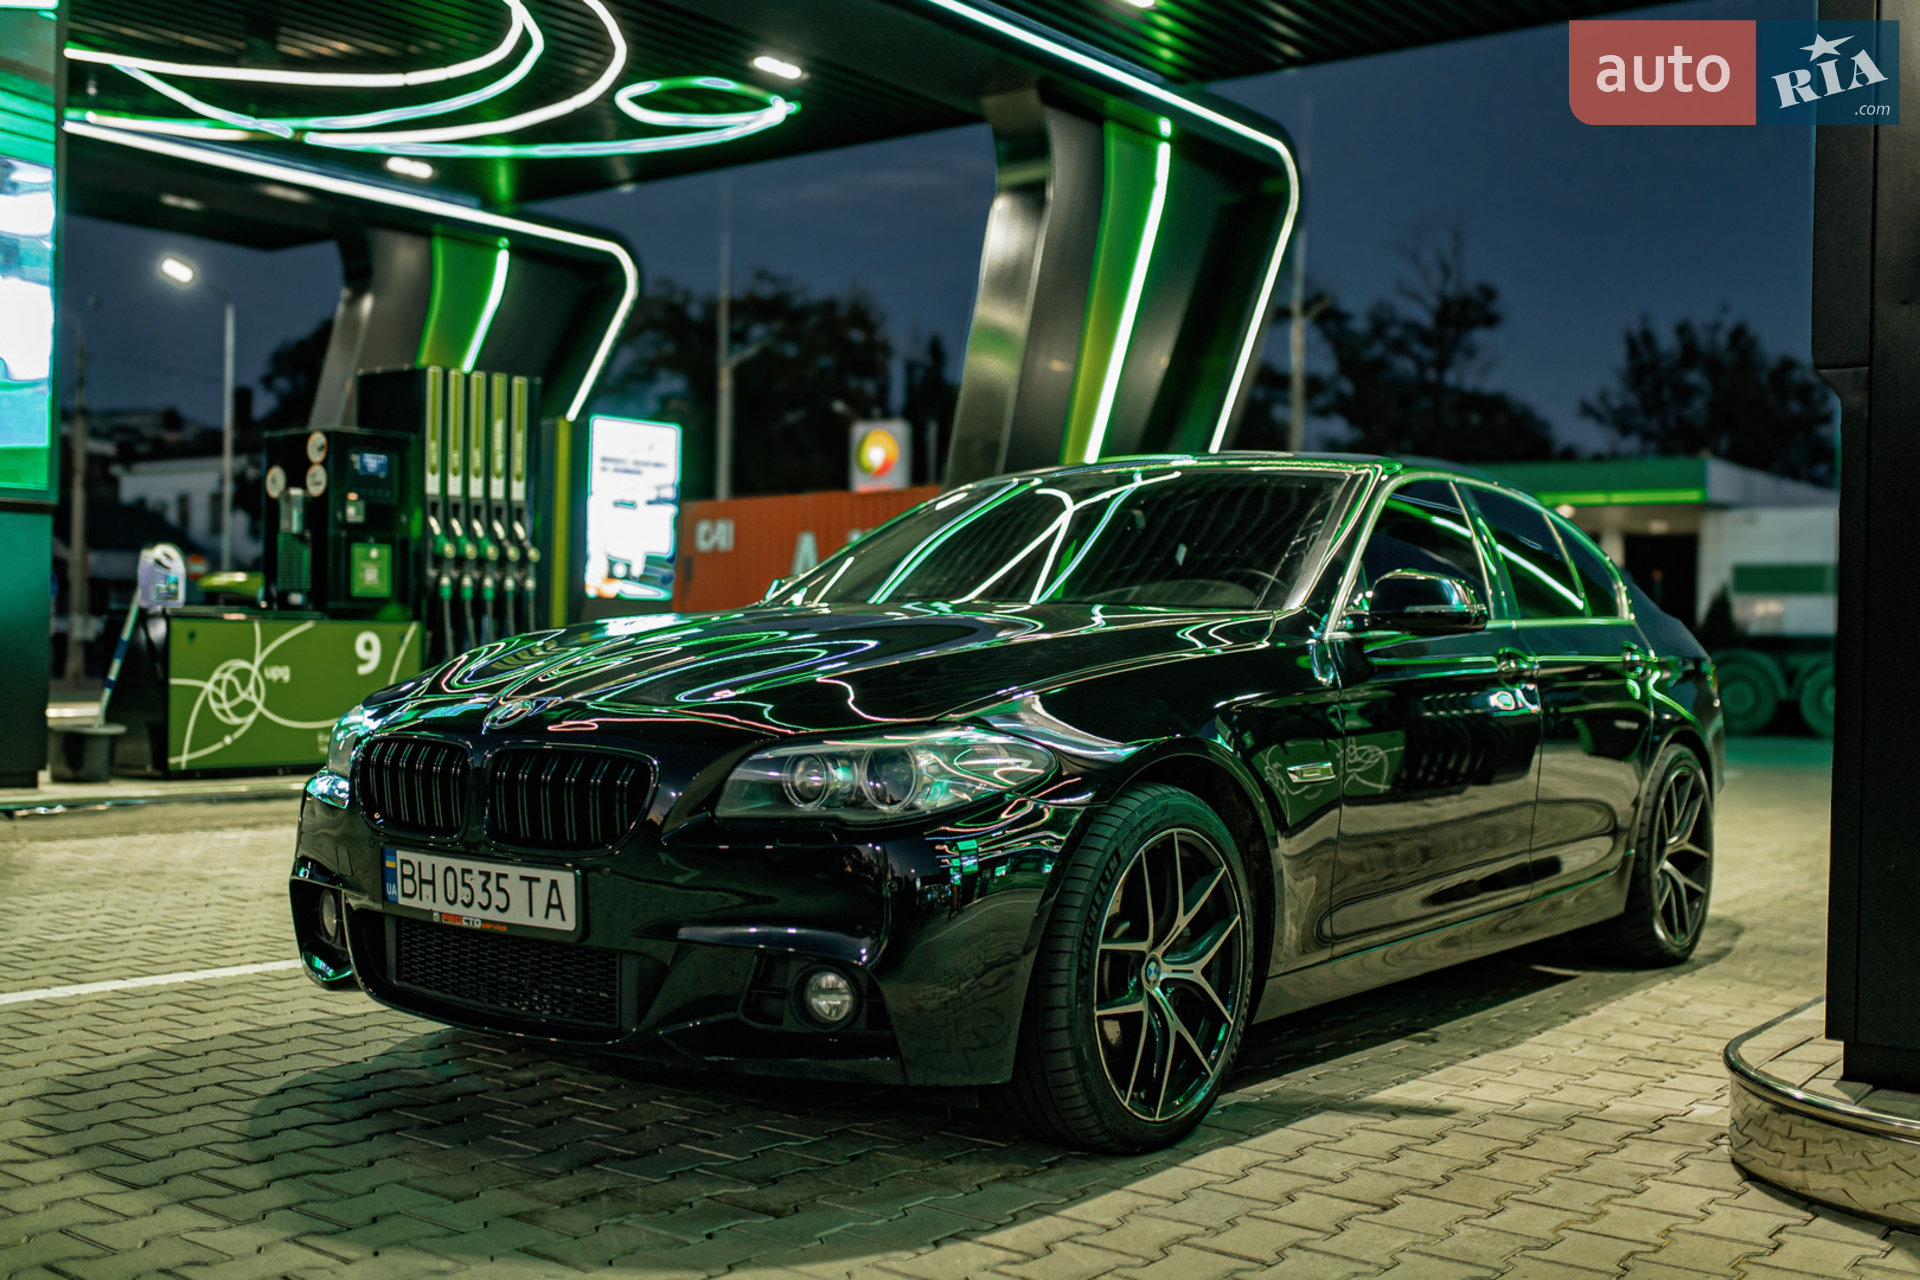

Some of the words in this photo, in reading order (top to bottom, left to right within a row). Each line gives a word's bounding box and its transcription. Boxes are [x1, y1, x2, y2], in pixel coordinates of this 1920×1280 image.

[263, 664, 291, 684] upg
[354, 630, 382, 676] 9
[386, 882, 398, 896] UA
[399, 858, 437, 903] BH
[443, 865, 511, 914] 0535
[519, 875, 567, 922] TA
[1081, 853, 1120, 969] MICHELIN
